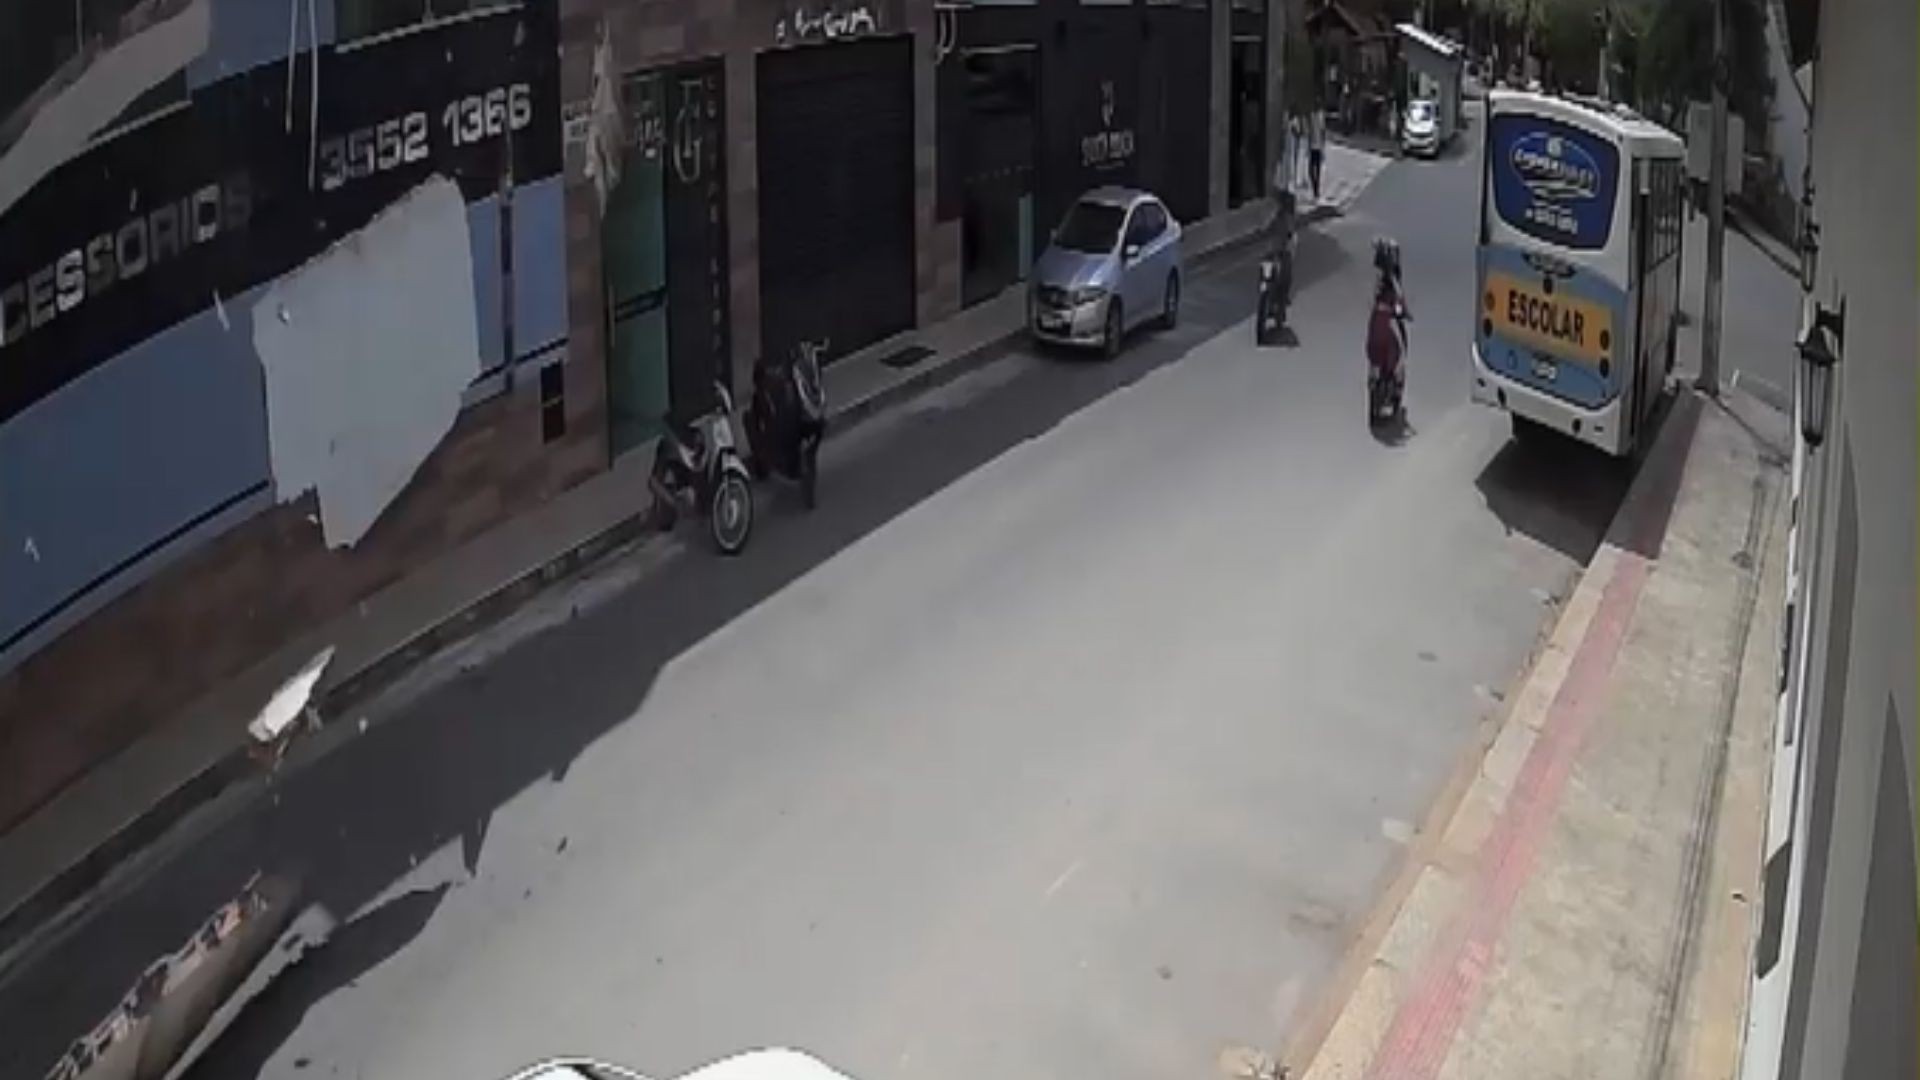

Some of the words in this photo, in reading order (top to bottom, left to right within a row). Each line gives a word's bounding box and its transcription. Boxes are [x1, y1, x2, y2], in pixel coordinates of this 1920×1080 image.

[320, 111, 429, 191] 3552
[442, 83, 532, 147] 1366
[1509, 288, 1585, 347] ESCOLAR
